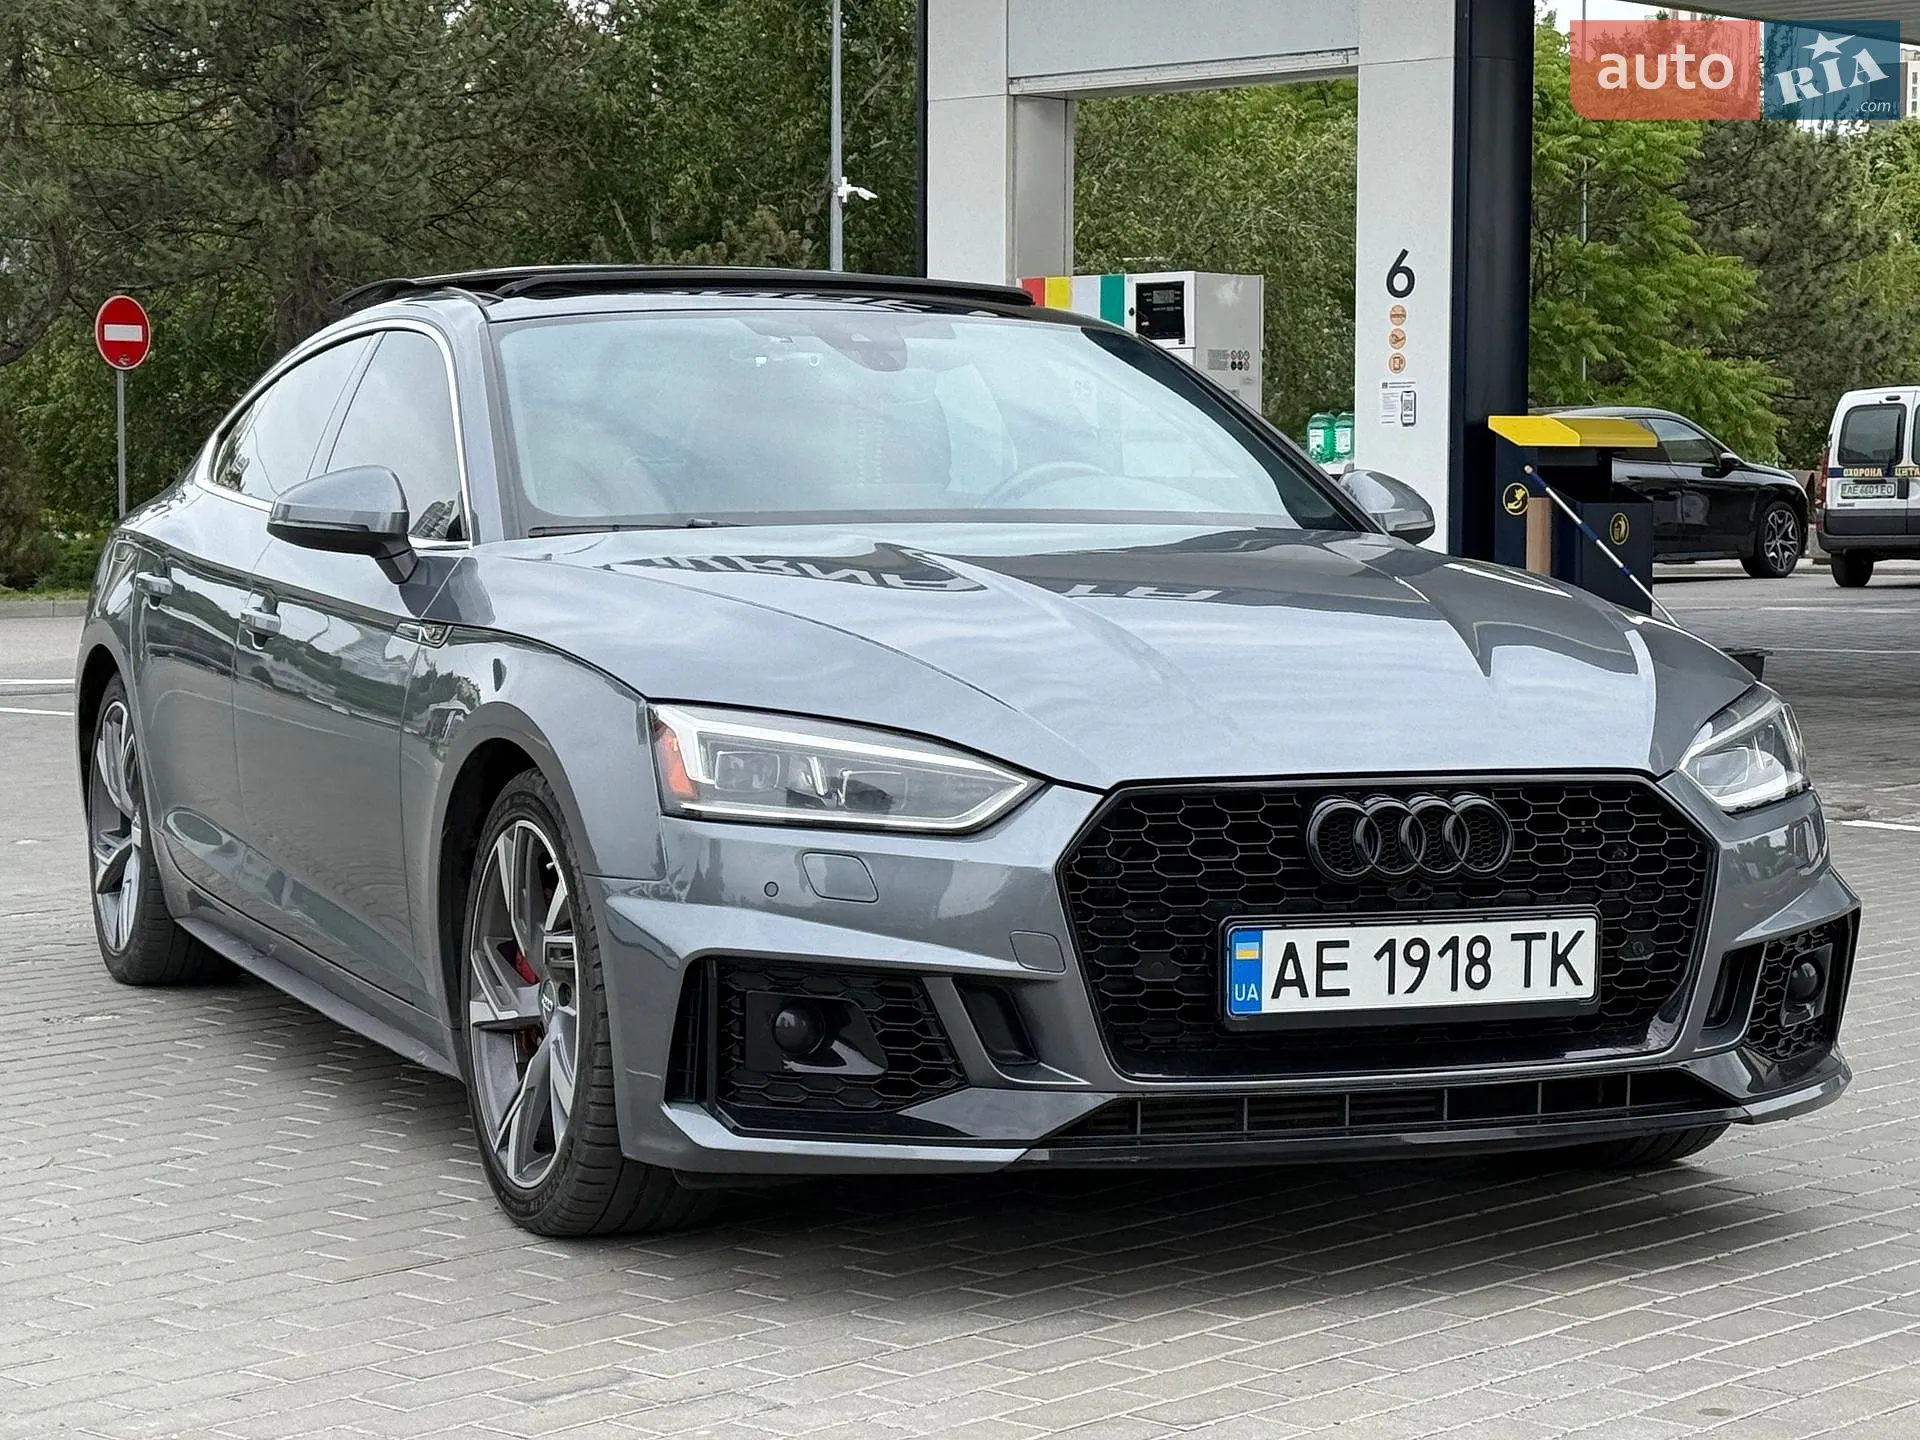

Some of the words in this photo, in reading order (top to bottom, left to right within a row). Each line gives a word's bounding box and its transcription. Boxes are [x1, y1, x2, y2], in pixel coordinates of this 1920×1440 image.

[1386, 248, 1415, 298] 6
[1271, 940, 1350, 999] AE
[1373, 935, 1492, 995] 1918
[1510, 930, 1585, 988] TK
[1234, 983, 1259, 1002] UA
